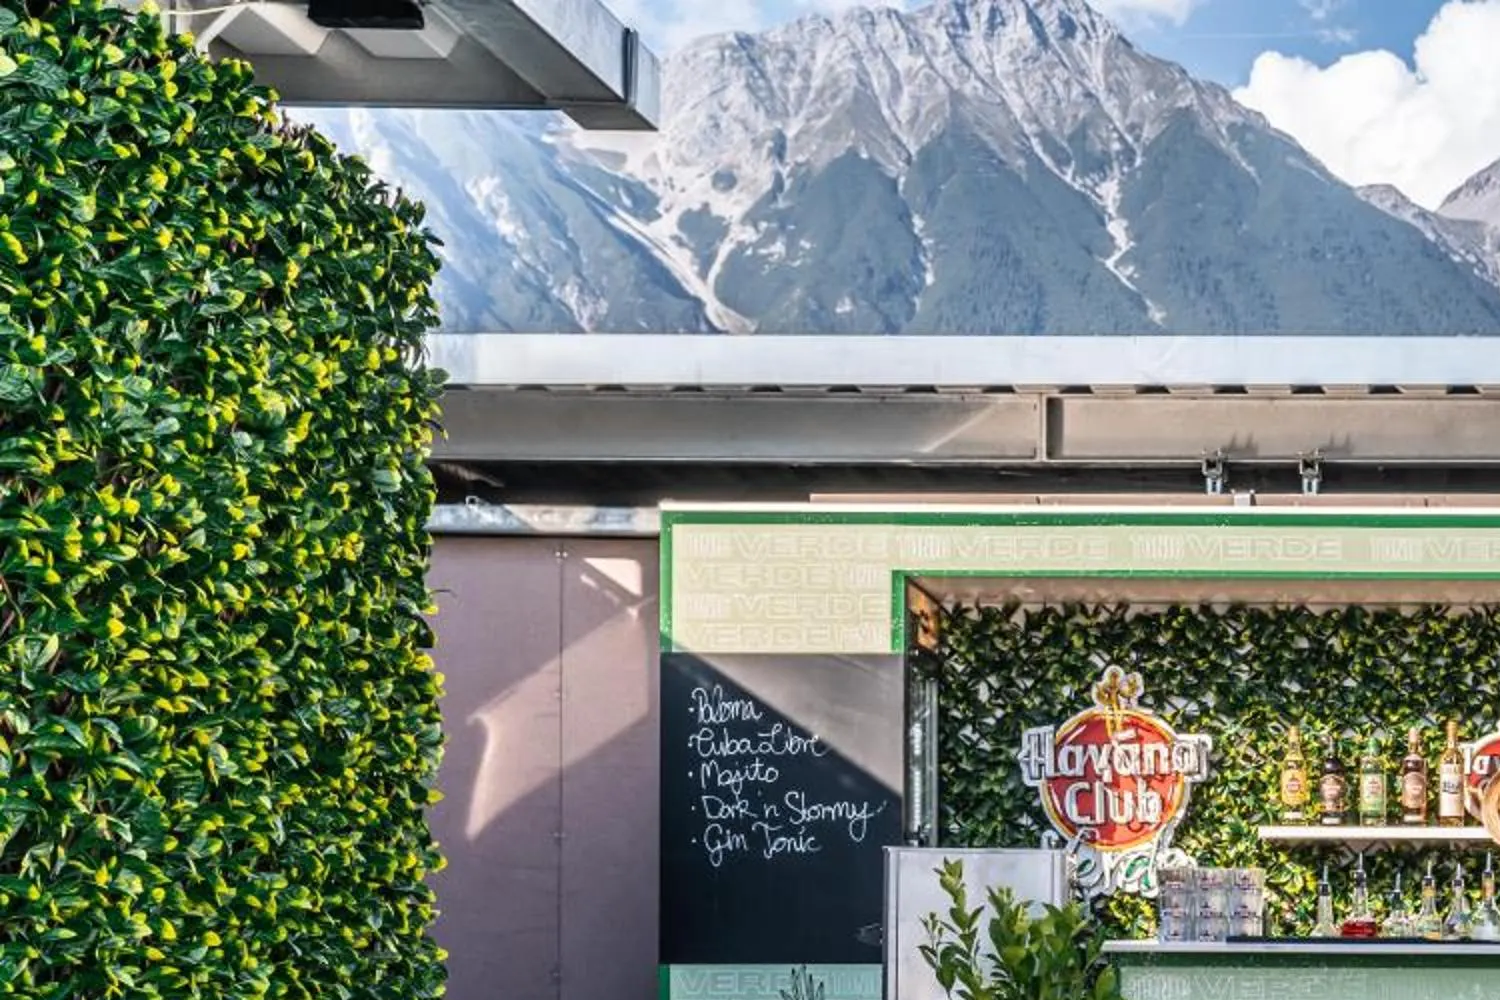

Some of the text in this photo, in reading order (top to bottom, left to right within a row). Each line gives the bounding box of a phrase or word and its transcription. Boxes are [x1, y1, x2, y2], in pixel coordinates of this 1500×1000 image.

[1184, 534, 1343, 562] VERDE
[691, 685, 763, 723] Paloma
[690, 723, 828, 757] Cuba Libre
[1020, 729, 1208, 783] Havana
[701, 759, 779, 795] Mojito
[702, 795, 757, 819] Dark
[784, 791, 887, 842] Stormy
[1064, 779, 1165, 827] Club
[703, 821, 822, 867] Gin Tonic
